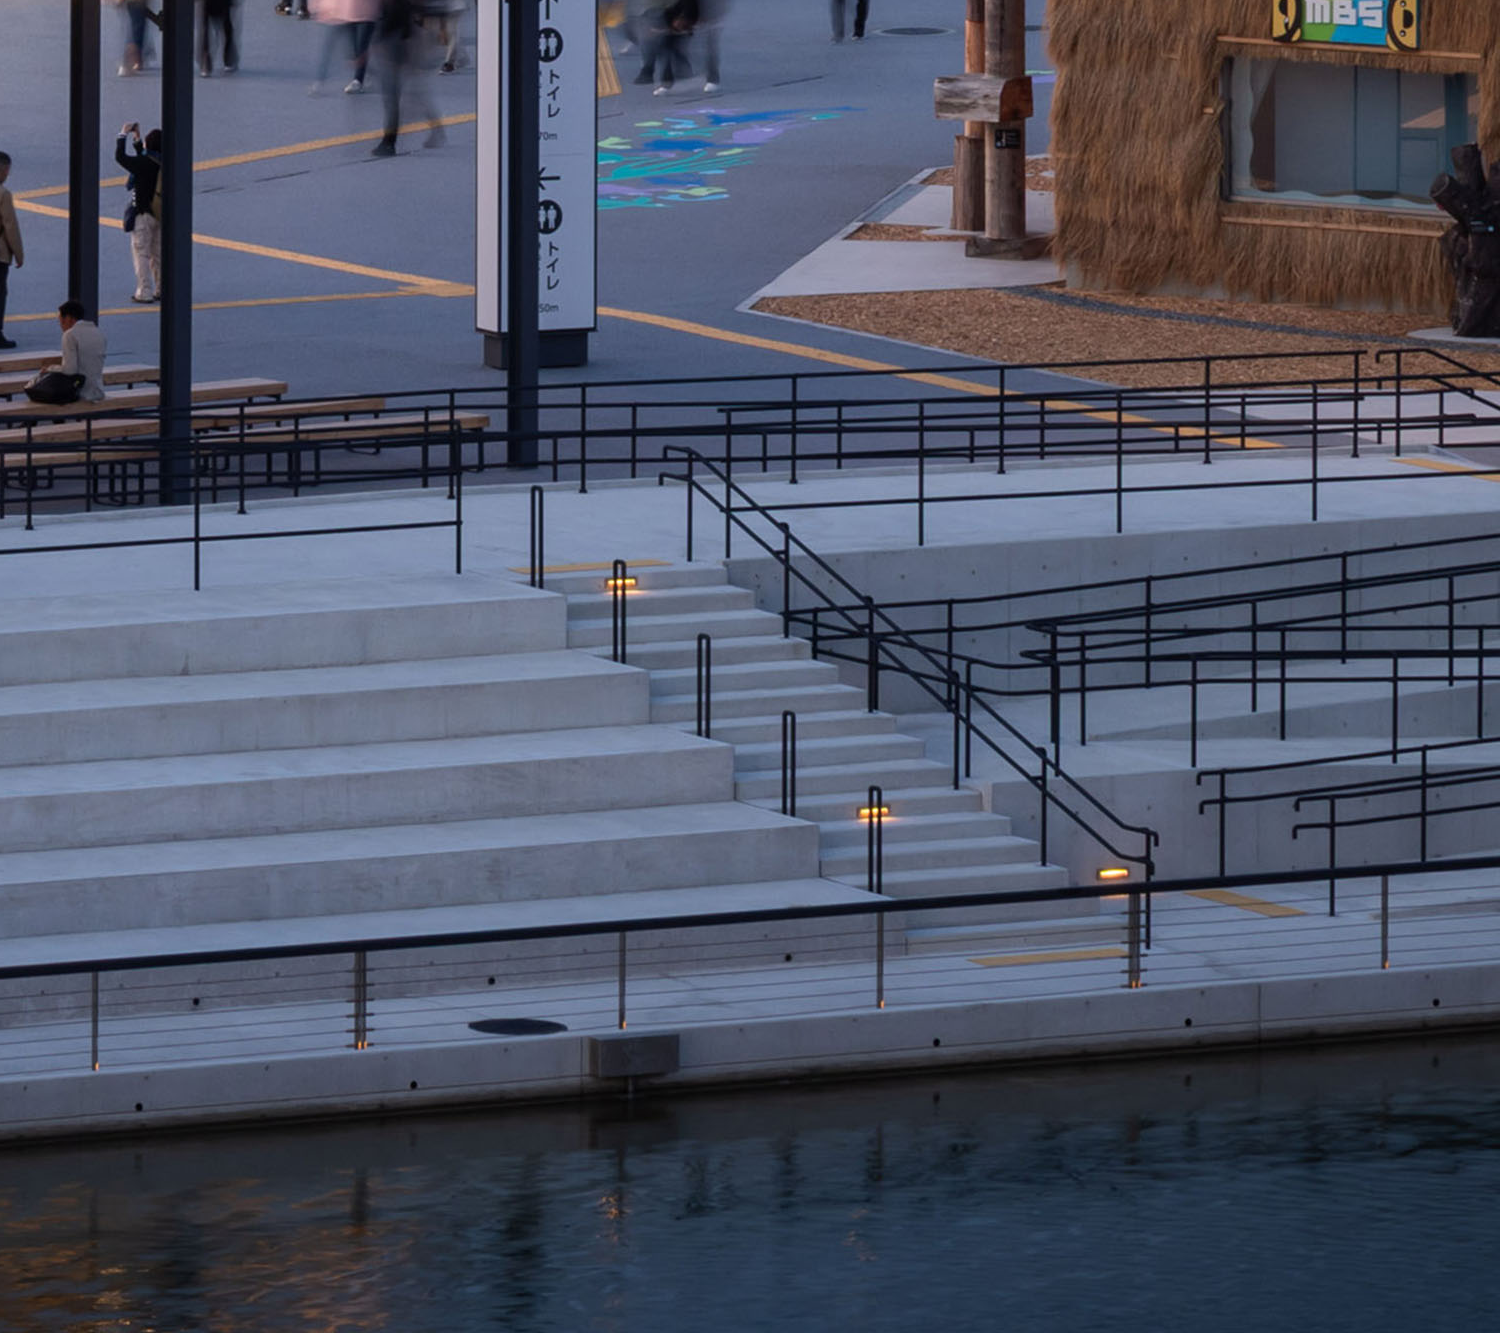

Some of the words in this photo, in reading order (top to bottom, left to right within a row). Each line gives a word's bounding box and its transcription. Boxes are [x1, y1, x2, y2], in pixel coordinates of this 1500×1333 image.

[547, 69, 560, 118] トイレ
[546, 241, 560, 290] トイレ
